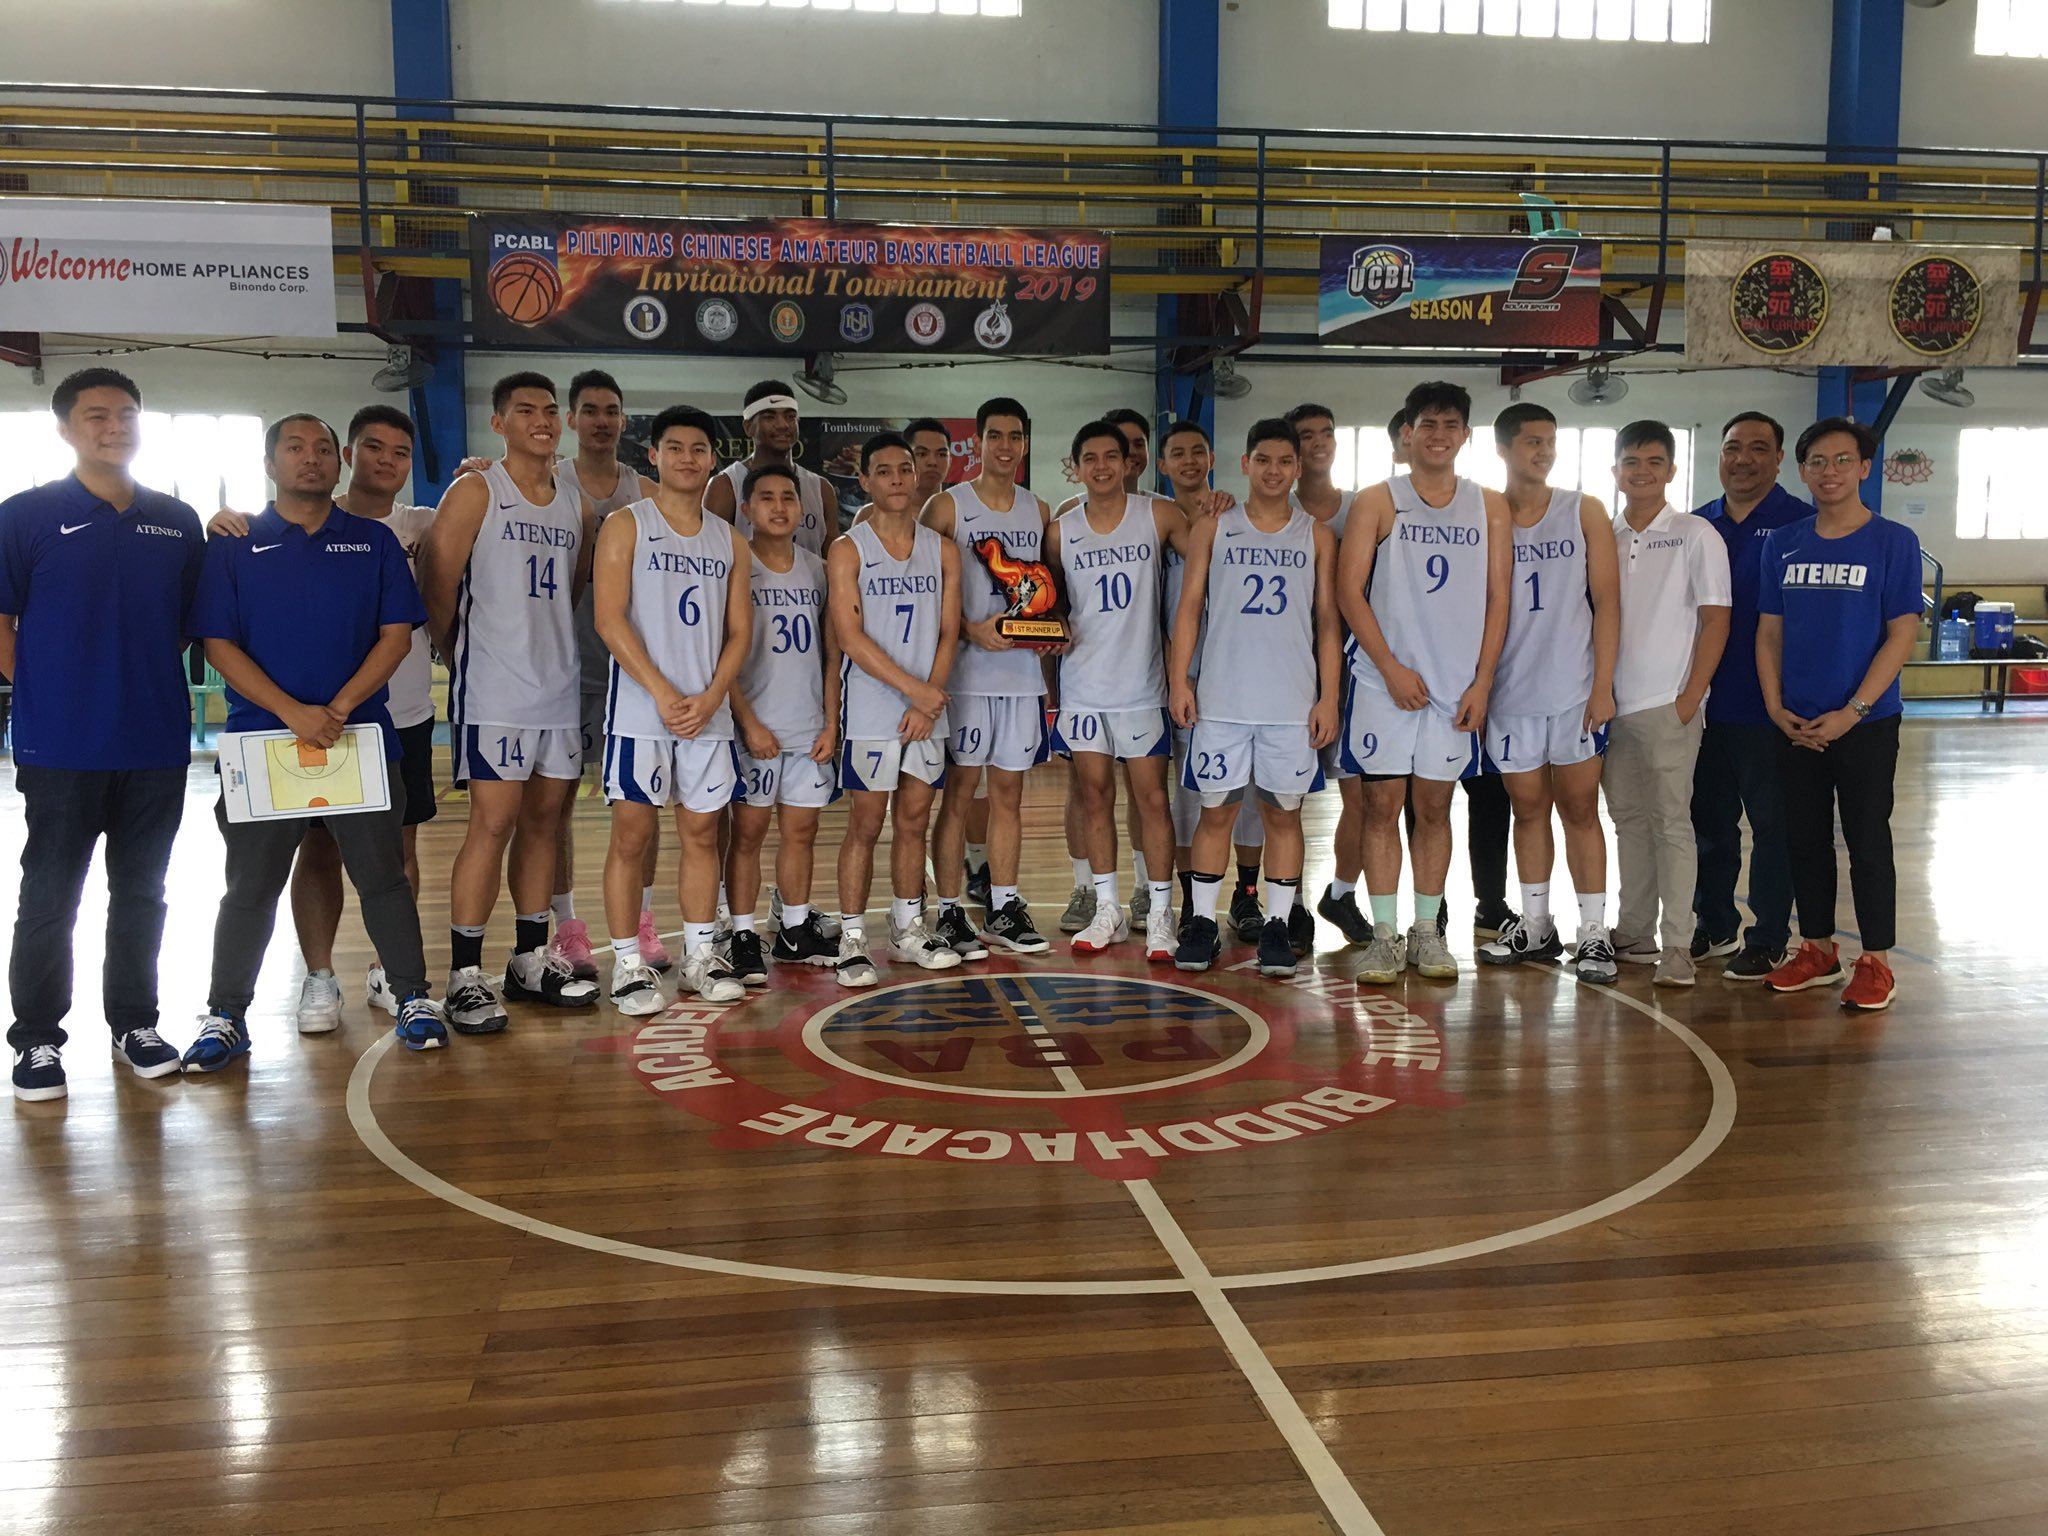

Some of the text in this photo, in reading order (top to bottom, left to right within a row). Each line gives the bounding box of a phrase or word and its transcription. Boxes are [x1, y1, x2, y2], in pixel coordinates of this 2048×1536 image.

[495, 234, 554, 250] PCABL
[566, 231, 1100, 269] PILIPINAS CHINESE AMATEUR BASKETBALL LEAGUE
[12, 237, 309, 283] Welcome HOME APPLIANCES
[230, 282, 309, 294] Binondo Corp.
[637, 263, 1097, 301] Invitational Tournament 2019
[1350, 263, 1412, 293] UCBL
[1410, 295, 1493, 325] SEASON 4
[821, 421, 882, 433] Tombstone
[135, 524, 183, 538] ATENEO
[501, 520, 576, 551] ATENEO
[1399, 522, 1480, 546] ATENEO
[1646, 537, 1683, 551] ATENEO
[325, 543, 371, 553] ATENEO
[1073, 543, 1151, 570] ATENEO
[1223, 547, 1307, 569] ATENEO
[526, 554, 558, 600] 14
[647, 551, 727, 579] ATENEO
[1425, 554, 1449, 594] 9
[1783, 562, 1868, 586] ATENEO
[751, 588, 822, 607] ATENEO
[865, 575, 937, 596] ATENEO
[1095, 571, 1132, 613] 10
[1240, 573, 1288, 615] 23
[1524, 571, 1545, 612] 1
[678, 584, 701, 626] 6
[771, 613, 811, 654] 30
[895, 604, 914, 643] 7
[1026, 626, 1051, 634] RUNNER
[956, 725, 982, 754] 19
[1068, 713, 1097, 741] 10
[496, 736, 525, 768] 14
[1362, 733, 1378, 759] 9
[1500, 734, 1512, 762] 1
[650, 764, 662, 793] 6
[866, 751, 883, 779] 7
[1197, 751, 1228, 780] 23
[749, 768, 774, 796] 30
[864, 1026, 1221, 1073] PBA
[738, 1086, 1396, 1162] BUDDHACARE
